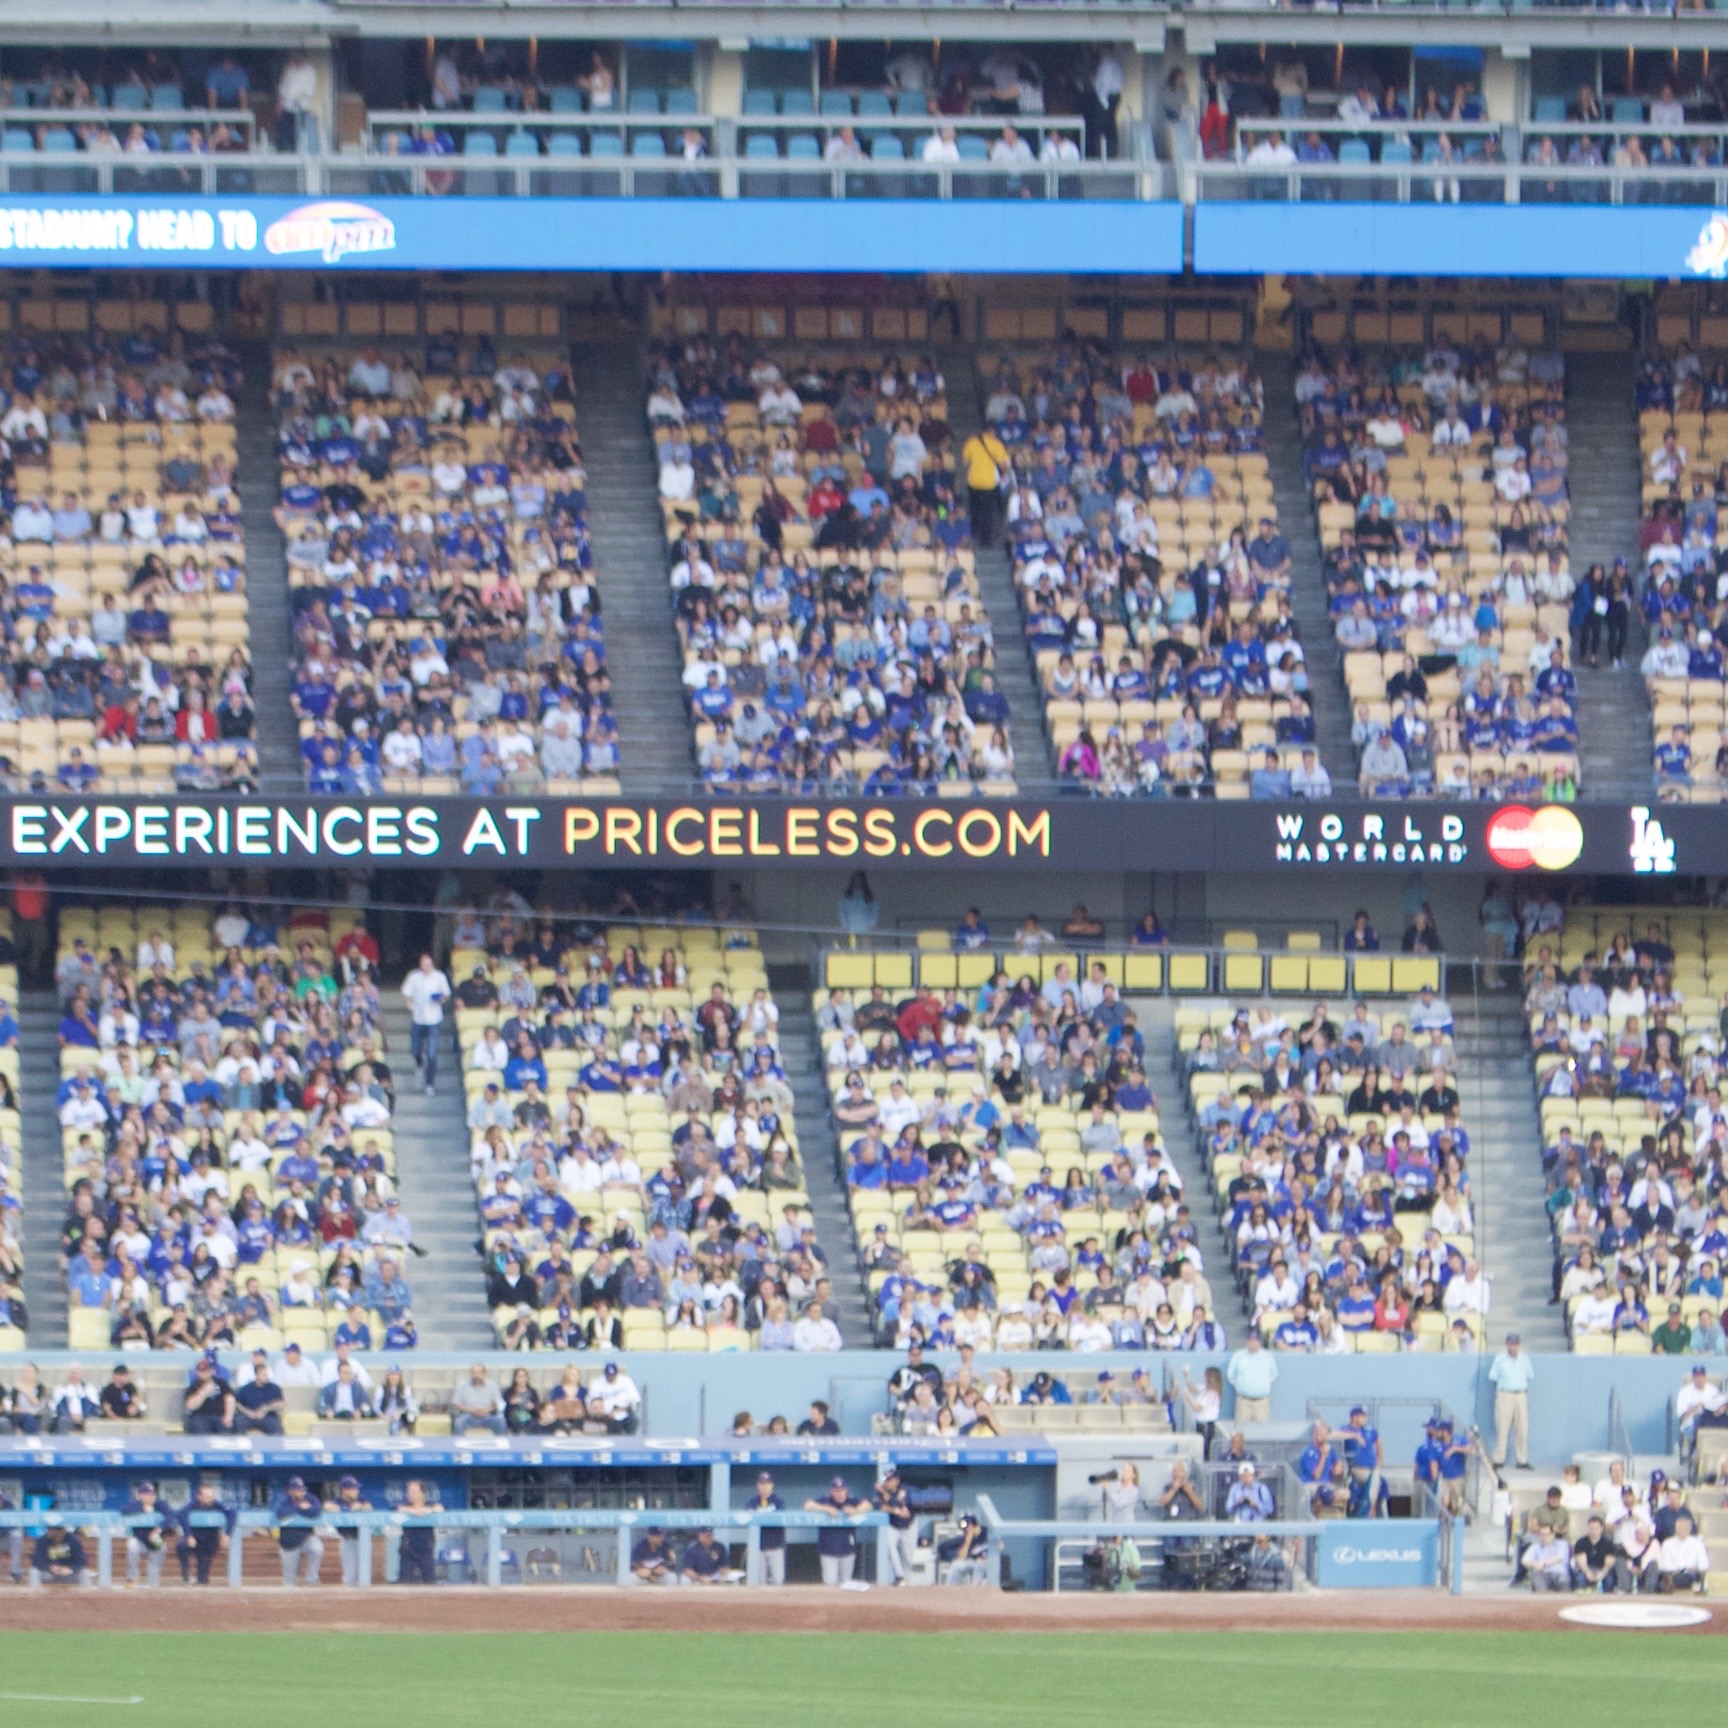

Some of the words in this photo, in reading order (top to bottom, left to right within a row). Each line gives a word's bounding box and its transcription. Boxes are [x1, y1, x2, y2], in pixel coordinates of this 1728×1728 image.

[138, 210, 214, 250] HEAD
[218, 210, 258, 251] TO
[12, 805, 440, 855] EXPERIENCES
[462, 807, 540, 855] AT
[563, 806, 1051, 858] PRICELESS.COM
[1276, 814, 1464, 841] WORLD
[1357, 1548, 1422, 1562] LEXUS
